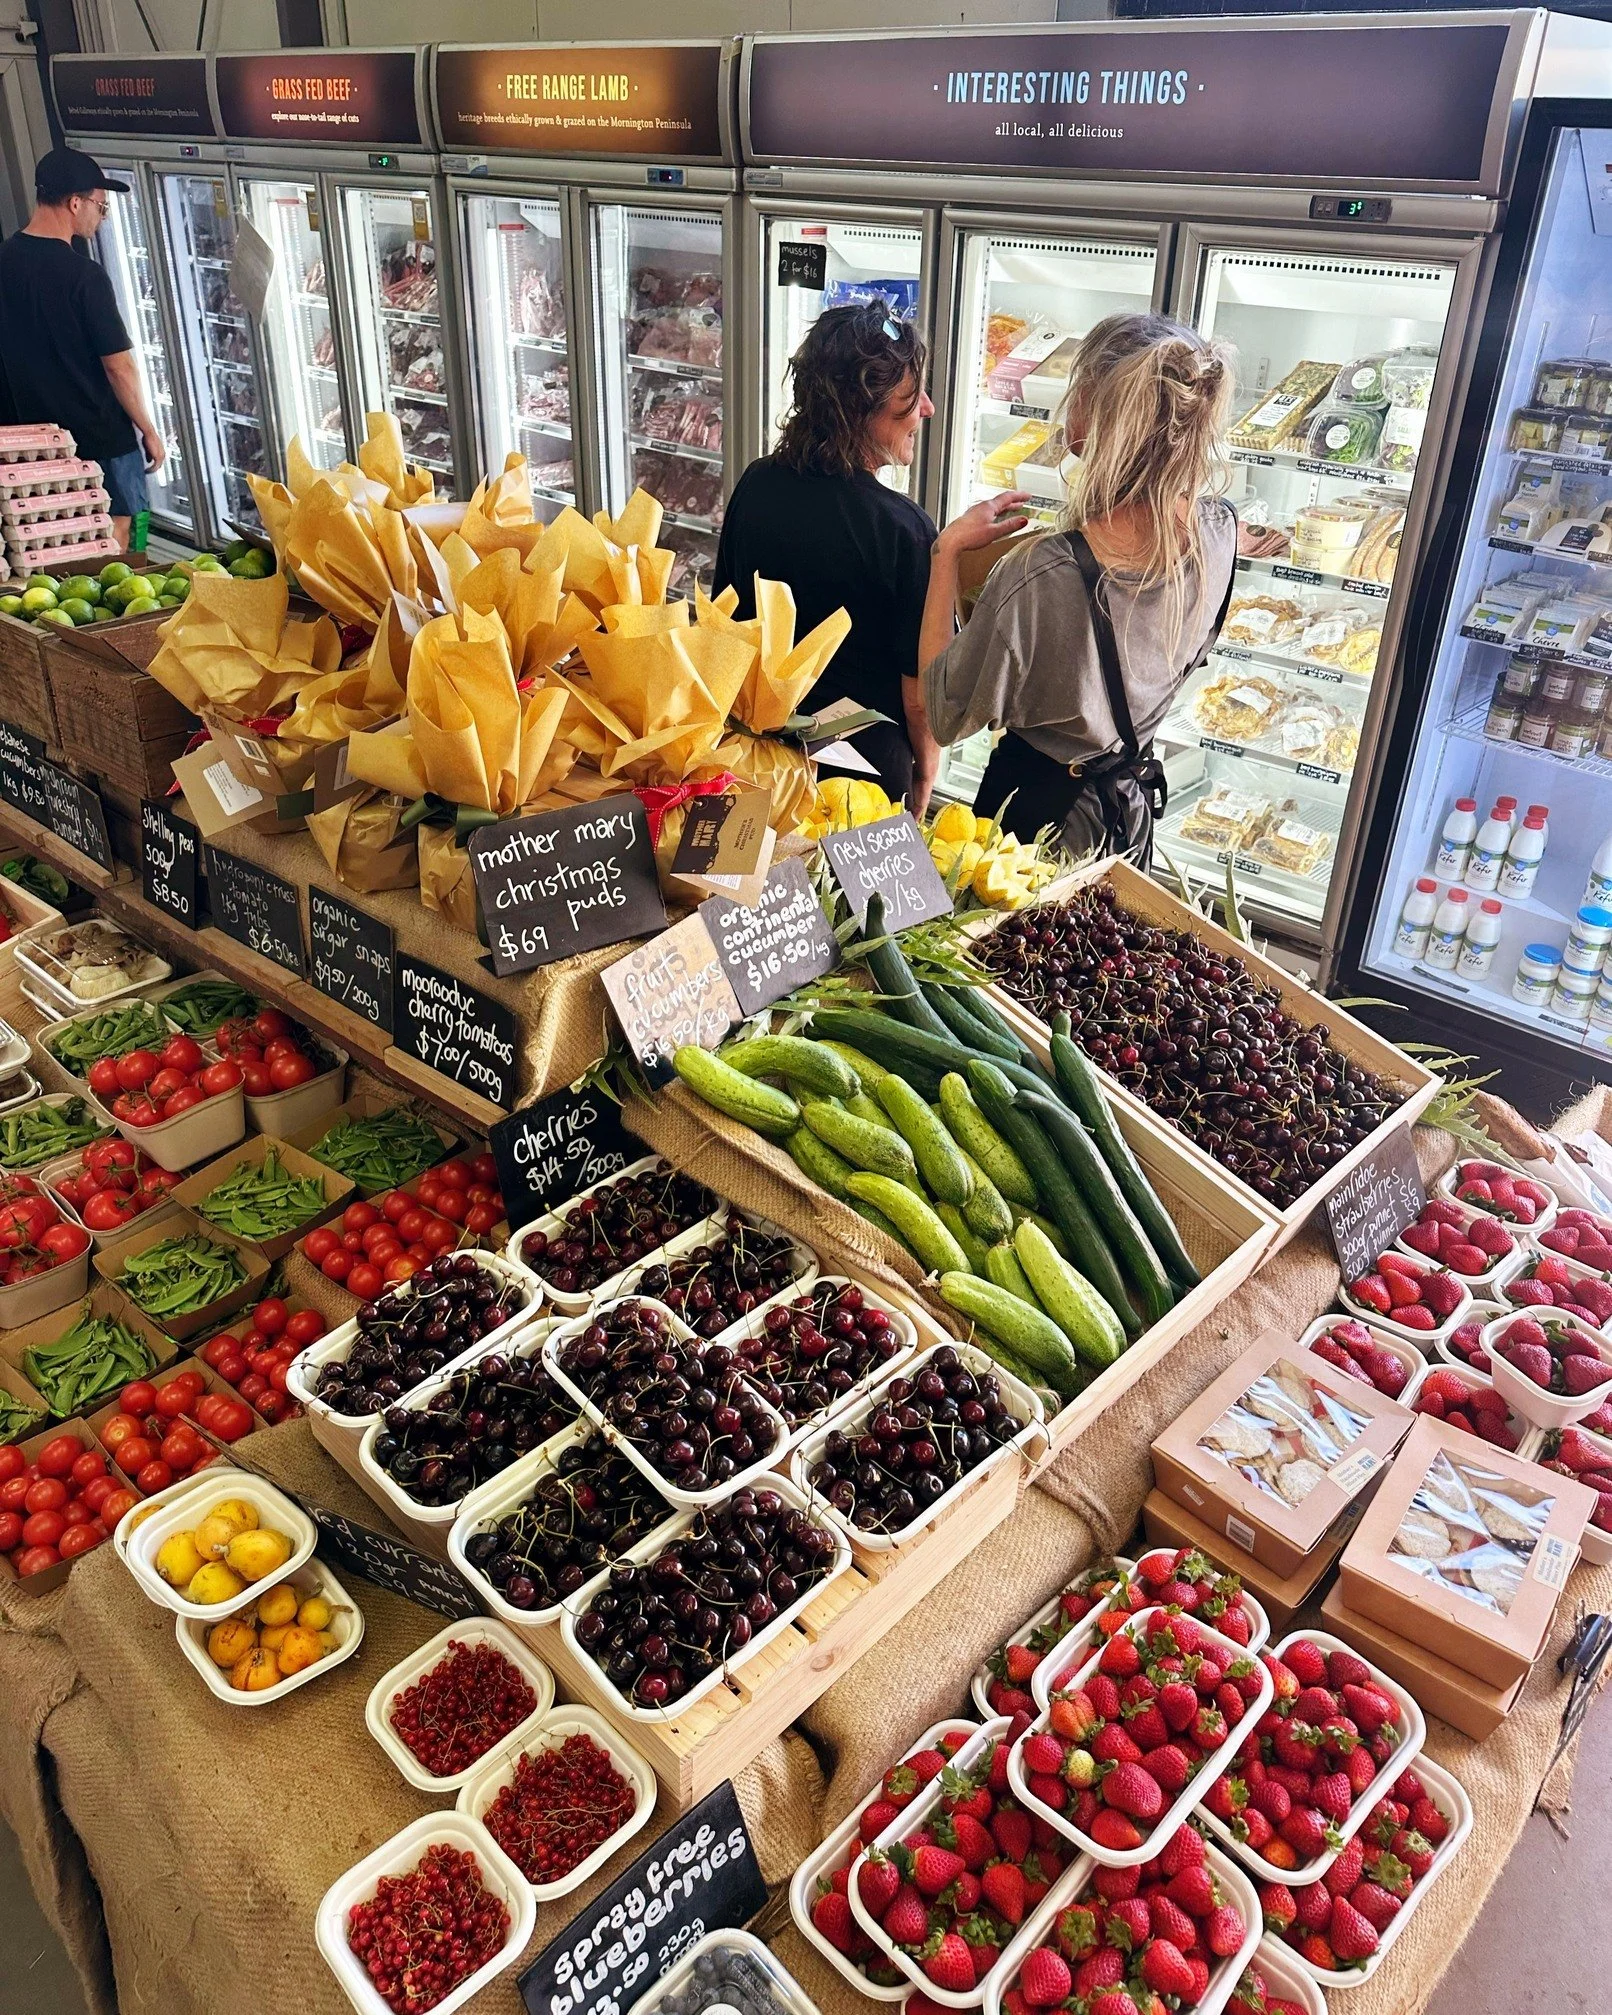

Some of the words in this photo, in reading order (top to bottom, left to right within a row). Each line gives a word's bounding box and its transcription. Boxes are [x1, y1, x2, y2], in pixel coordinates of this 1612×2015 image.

[272, 78, 303, 100] GRASS
[305, 79, 324, 100] FED
[326, 79, 351, 100] BEEF
[506, 74, 538, 99] FREE
[543, 75, 586, 100] RANGE
[591, 75, 629, 101] LAMB
[947, 71, 1090, 104] INTERESTING
[1100, 70, 1188, 105] THINGS
[458, 112, 483, 125] heritage
[483, 112, 504, 123] breeds
[506, 113, 532, 127] ethically
[534, 116, 554, 127] grown
[556, 115, 562, 125] &
[563, 115, 585, 128] grazed
[587, 117, 596, 126] on
[597, 115, 609, 127] the
[611, 116, 653, 130] Mornington
[655, 117, 692, 129] Peninsula
[995, 123, 1009, 136] all
[1013, 123, 1045, 138] local,
[1049, 124, 1063, 137] all
[1068, 124, 1123, 138] delicious
[781, 246, 818, 260] mussels
[781, 259, 788, 272] 2
[791, 261, 801, 276] for
[803, 262, 818, 279] $16
[1533, 636, 1560, 648] Chevre
[477, 830, 561, 872] mother
[574, 811, 637, 850] mary
[833, 830, 868, 865] new
[867, 822, 915, 853] season
[496, 856, 621, 910] christmas
[859, 852, 915, 890] cherries
[1472, 860, 1492, 875] Kefir
[1506, 870, 1527, 884] Kefir
[153, 869, 190, 914] $8.50
[229, 881, 269, 914] tomato
[313, 896, 361, 931] organic
[566, 881, 627, 932] puds
[720, 880, 787, 927] orgnic
[723, 883, 819, 949] continental
[313, 922, 348, 957] sugar
[355, 944, 391, 980] snaps
[498, 924, 550, 962] $69
[728, 915, 817, 965] cucumber
[1434, 943, 1455, 955] Kefir
[1463, 953, 1484, 966] Kefir
[402, 968, 476, 1017] moorooduc
[627, 949, 678, 1013] fruit
[633, 961, 722, 1039] cucumbers
[409, 998, 454, 1043] cherry
[1336, 1167, 1401, 1238] strawberries
[308, 1506, 357, 1542] red
[365, 1535, 464, 1589] currants
[550, 1826, 746, 2015] blueberries
[554, 1887, 646, 1985] spray
[647, 1824, 716, 1894] free
[658, 1917, 705, 1962] 230g
